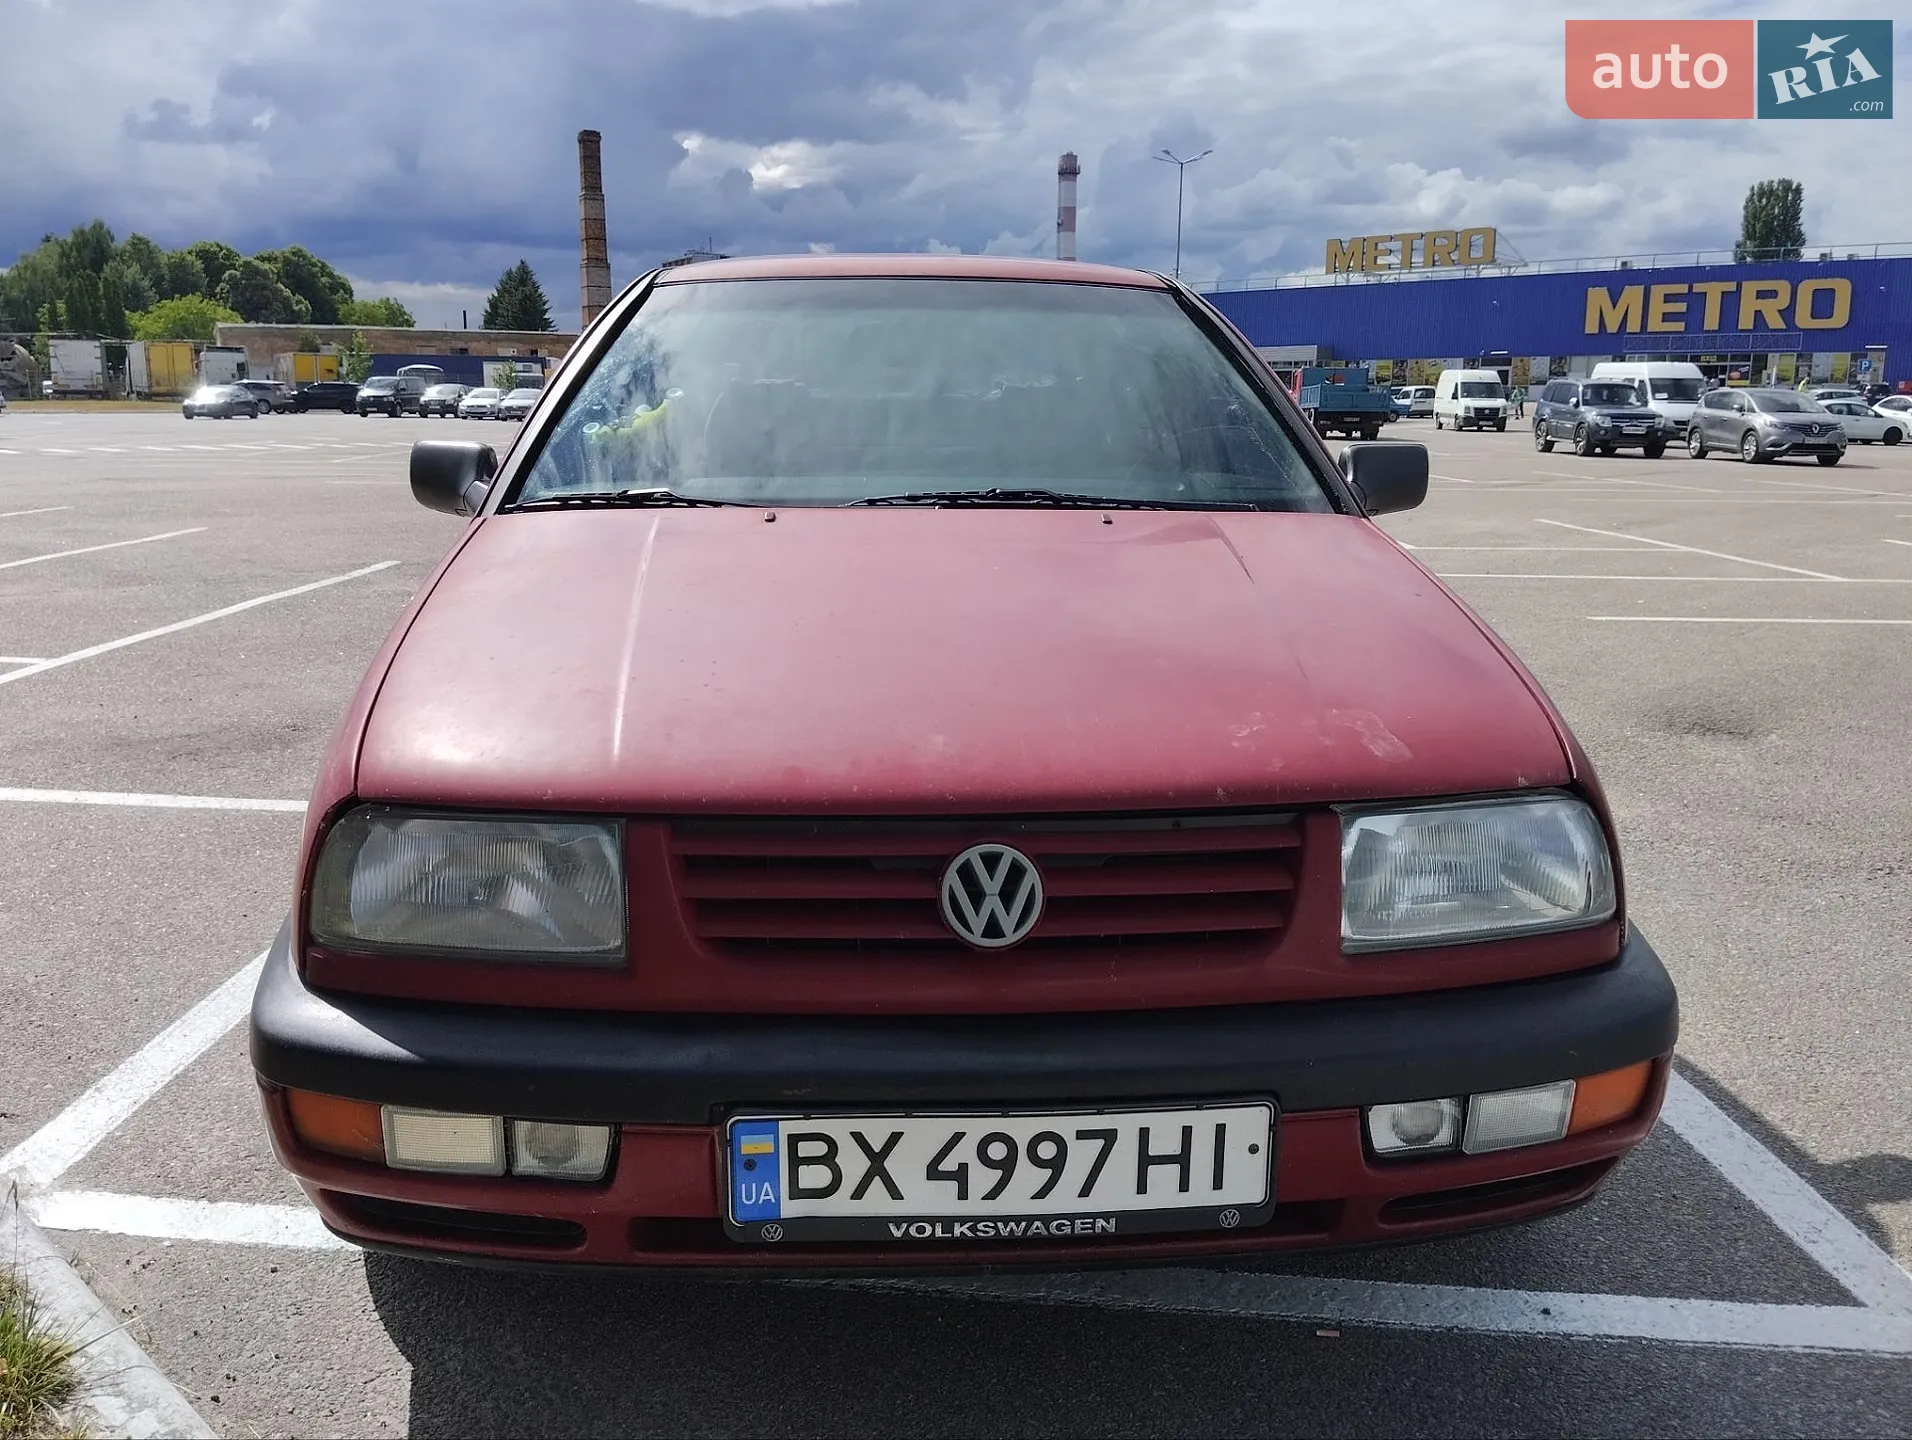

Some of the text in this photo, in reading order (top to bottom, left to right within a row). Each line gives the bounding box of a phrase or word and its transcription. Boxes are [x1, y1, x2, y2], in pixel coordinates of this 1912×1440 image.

[1326, 227, 1496, 275] METRO
[1584, 277, 1852, 334] METRO
[787, 1123, 1226, 1201] BX 4997 HI
[742, 1182, 776, 1205] UA
[887, 1217, 1117, 1238] VOLKSWAGEN
